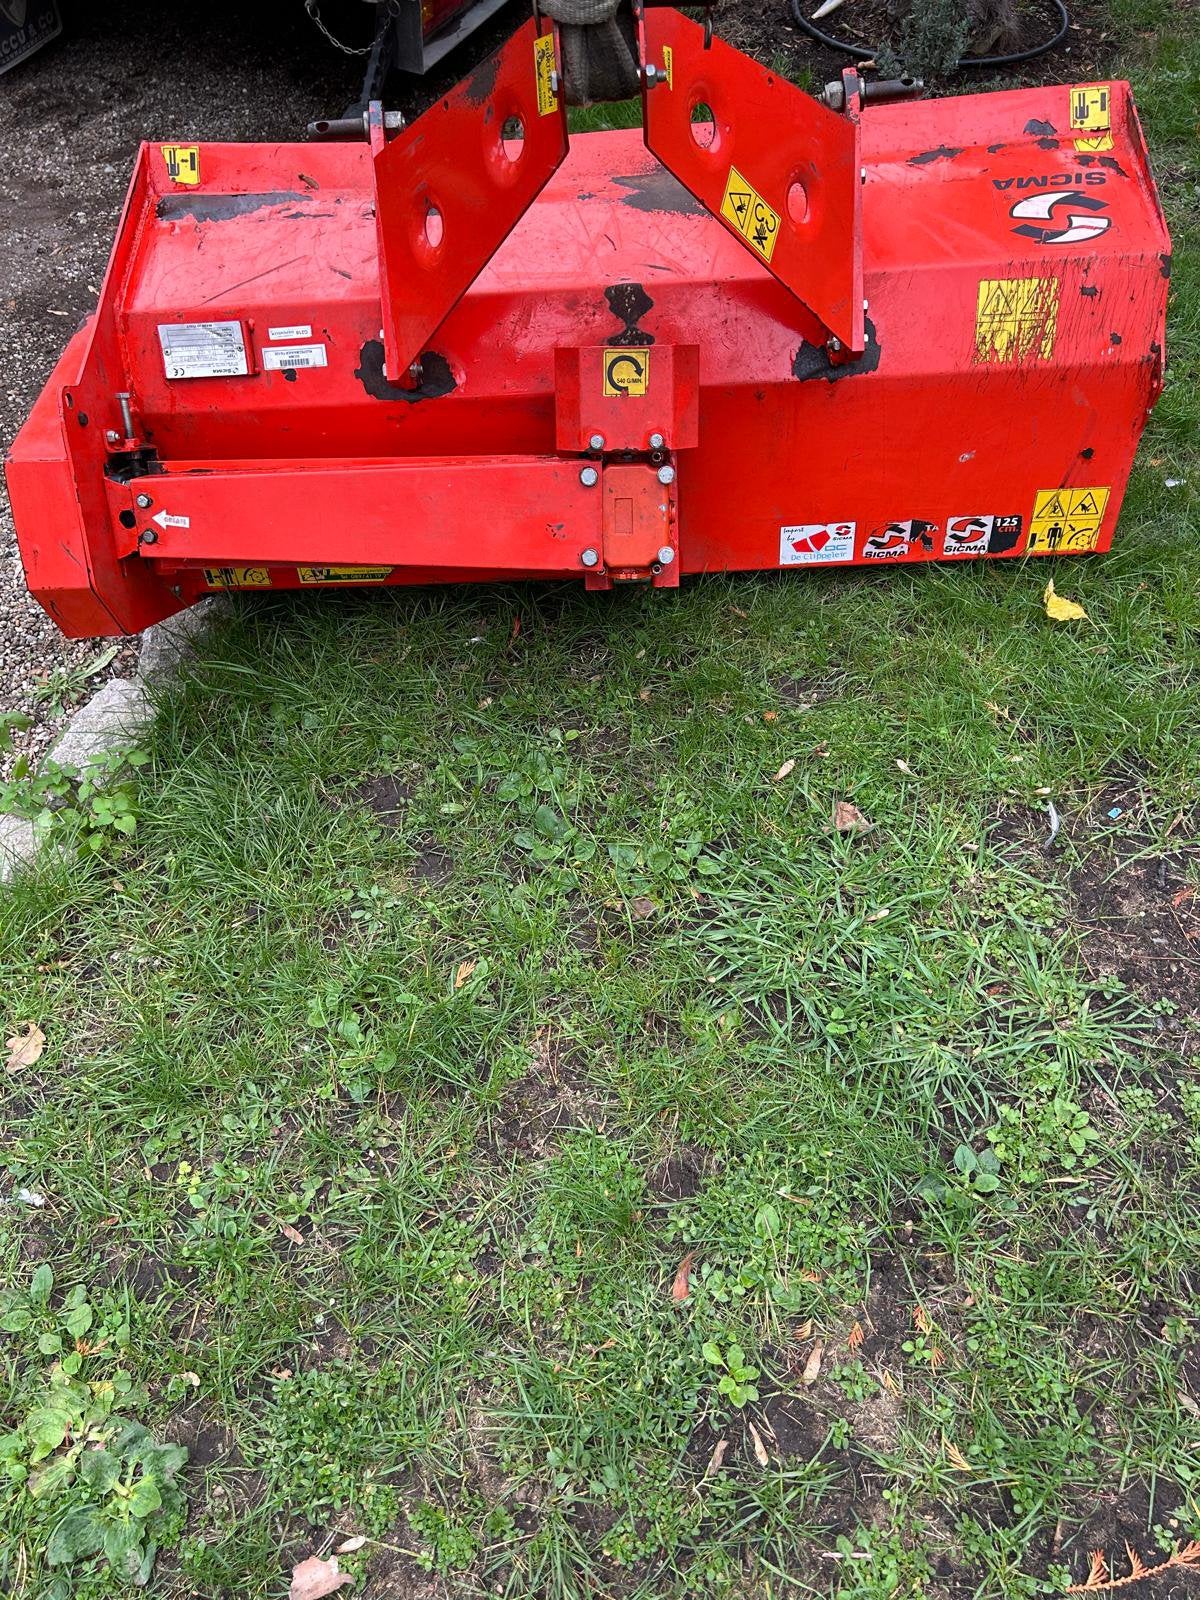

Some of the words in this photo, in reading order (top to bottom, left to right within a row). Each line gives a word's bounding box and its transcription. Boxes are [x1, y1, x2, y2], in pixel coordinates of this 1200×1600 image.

[992, 171, 1106, 191] SICMA
[996, 517, 1018, 527] 125
[787, 534, 796, 542] by
[944, 544, 986, 553] SICMA
[803, 552, 848, 561] Clippeleir
[864, 550, 905, 559] SICMA
